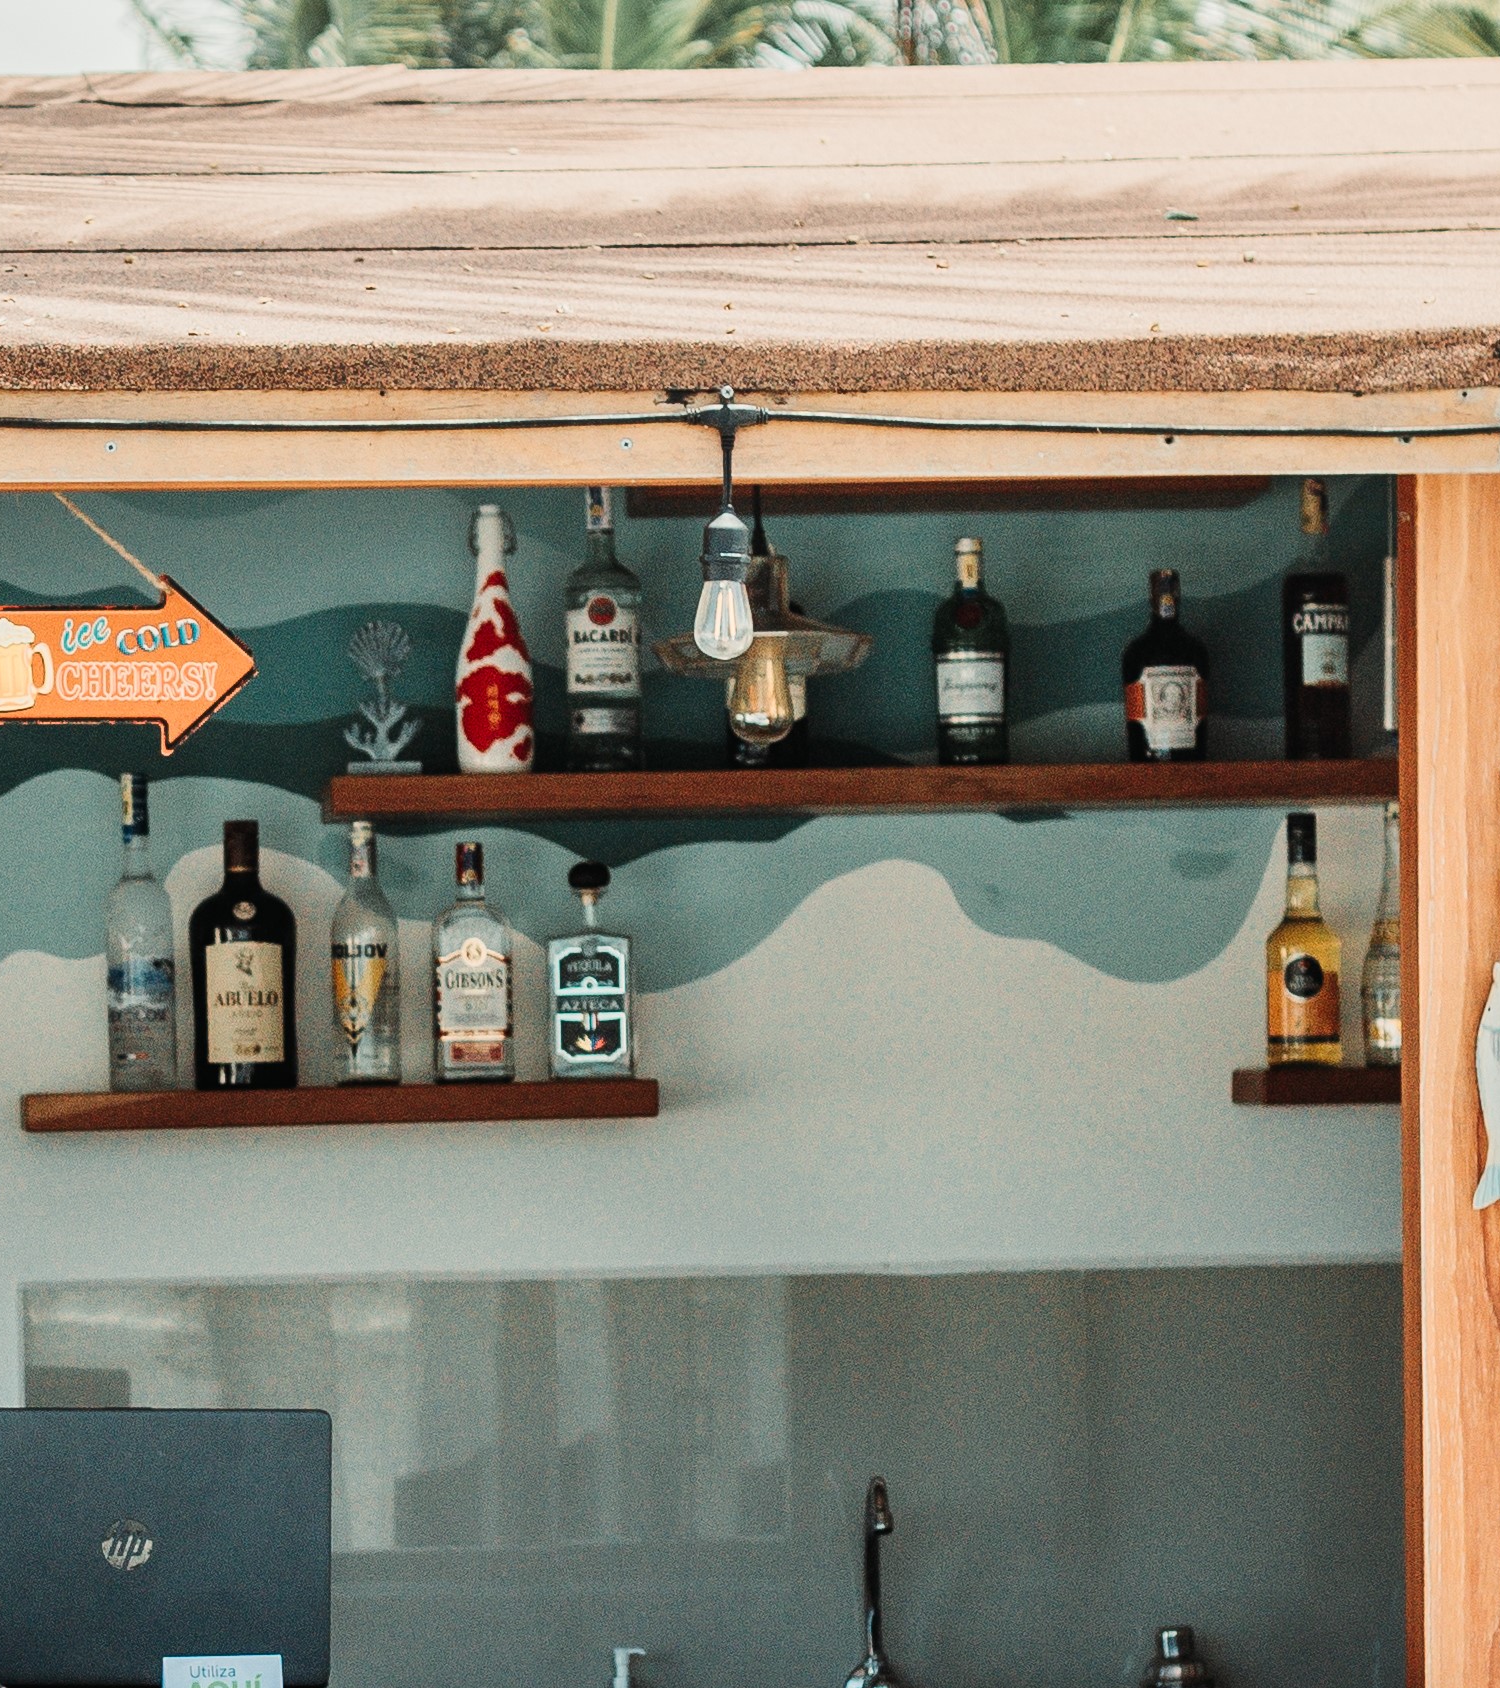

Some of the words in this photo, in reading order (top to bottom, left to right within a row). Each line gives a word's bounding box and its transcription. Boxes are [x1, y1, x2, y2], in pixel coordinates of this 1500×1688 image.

[60, 616, 110, 655] ice
[115, 618, 201, 656] COLD
[56, 661, 217, 702] CHEERS!
[214, 990, 280, 1008] ABUELO
[560, 998, 619, 1013] AZTECA
[102, 1519, 153, 1571] hp
[190, 1665, 236, 1678] Utiliza
